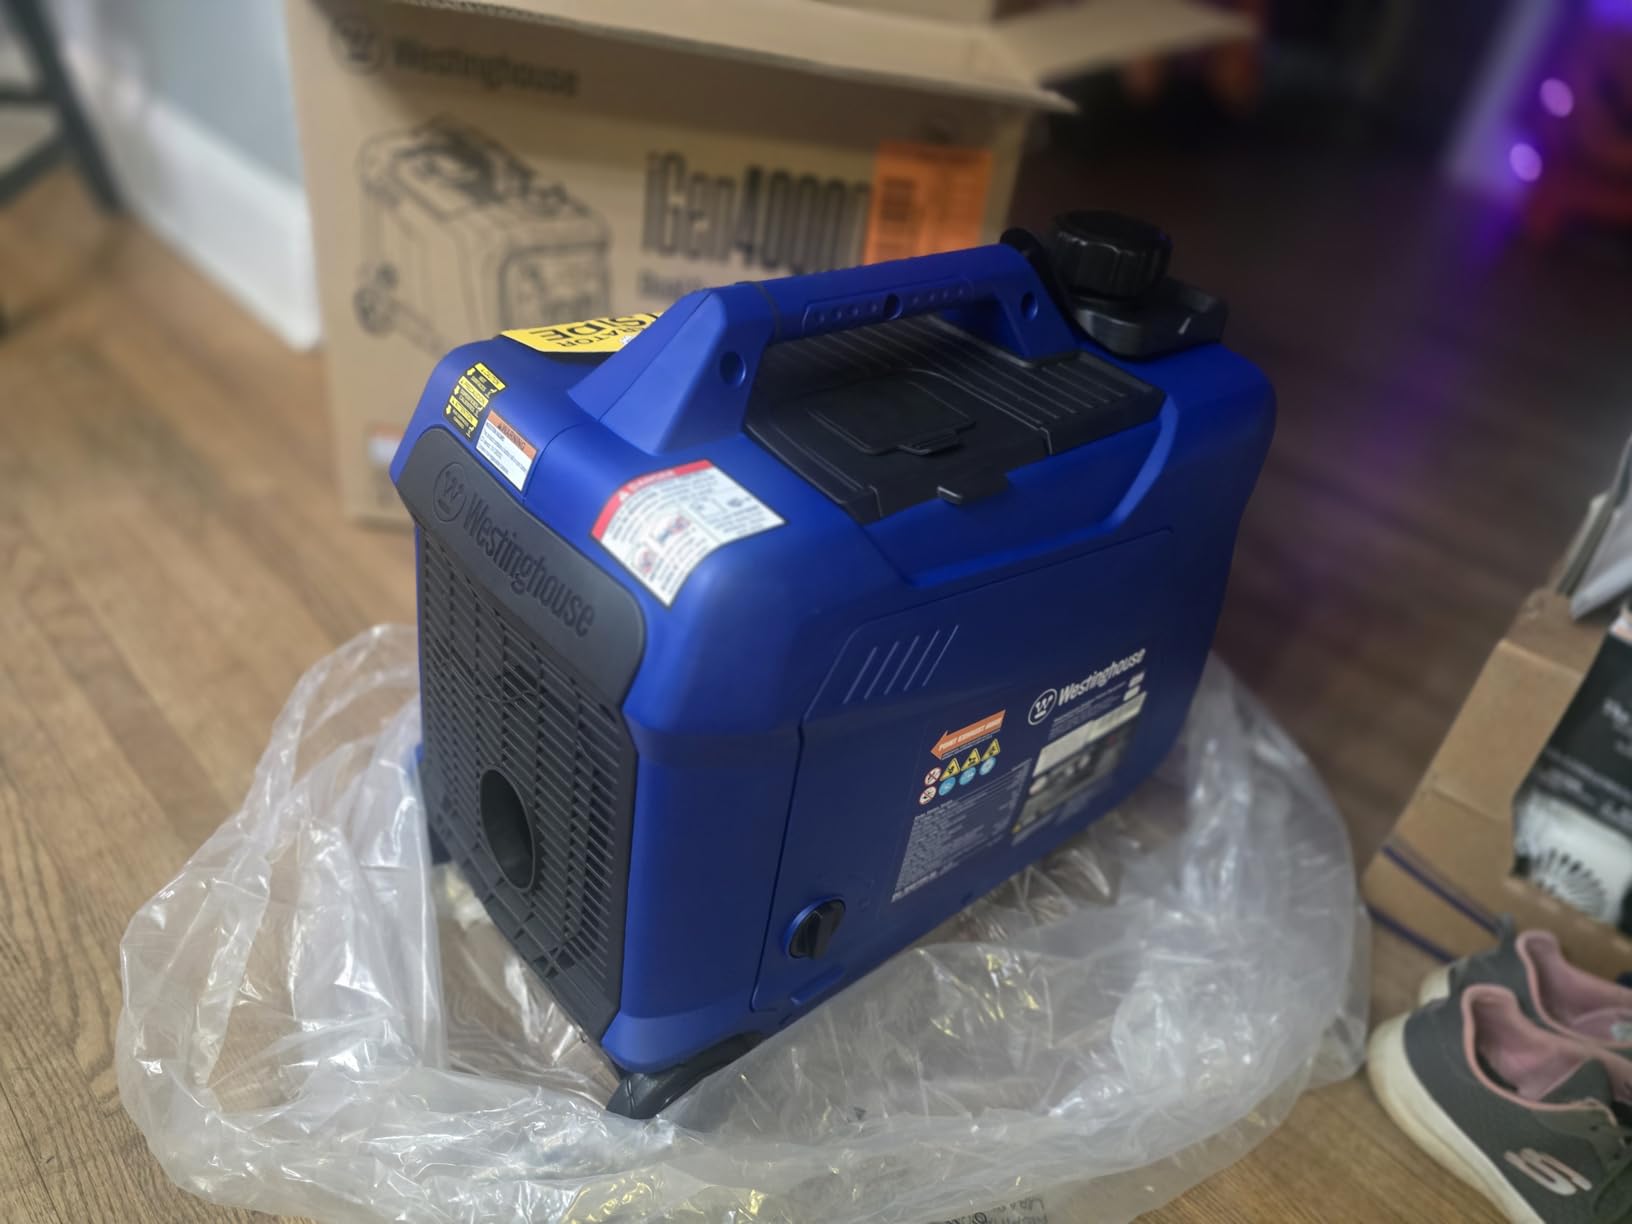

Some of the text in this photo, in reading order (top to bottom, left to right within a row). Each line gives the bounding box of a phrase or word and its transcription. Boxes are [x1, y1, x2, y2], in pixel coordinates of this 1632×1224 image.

[530, 313, 657, 339] SIDE
[557, 325, 643, 347] RATOR
[500, 422, 527, 449] WARNING
[463, 491, 595, 638] Westinghouse
[1058, 648, 1146, 706] Westinghouse
